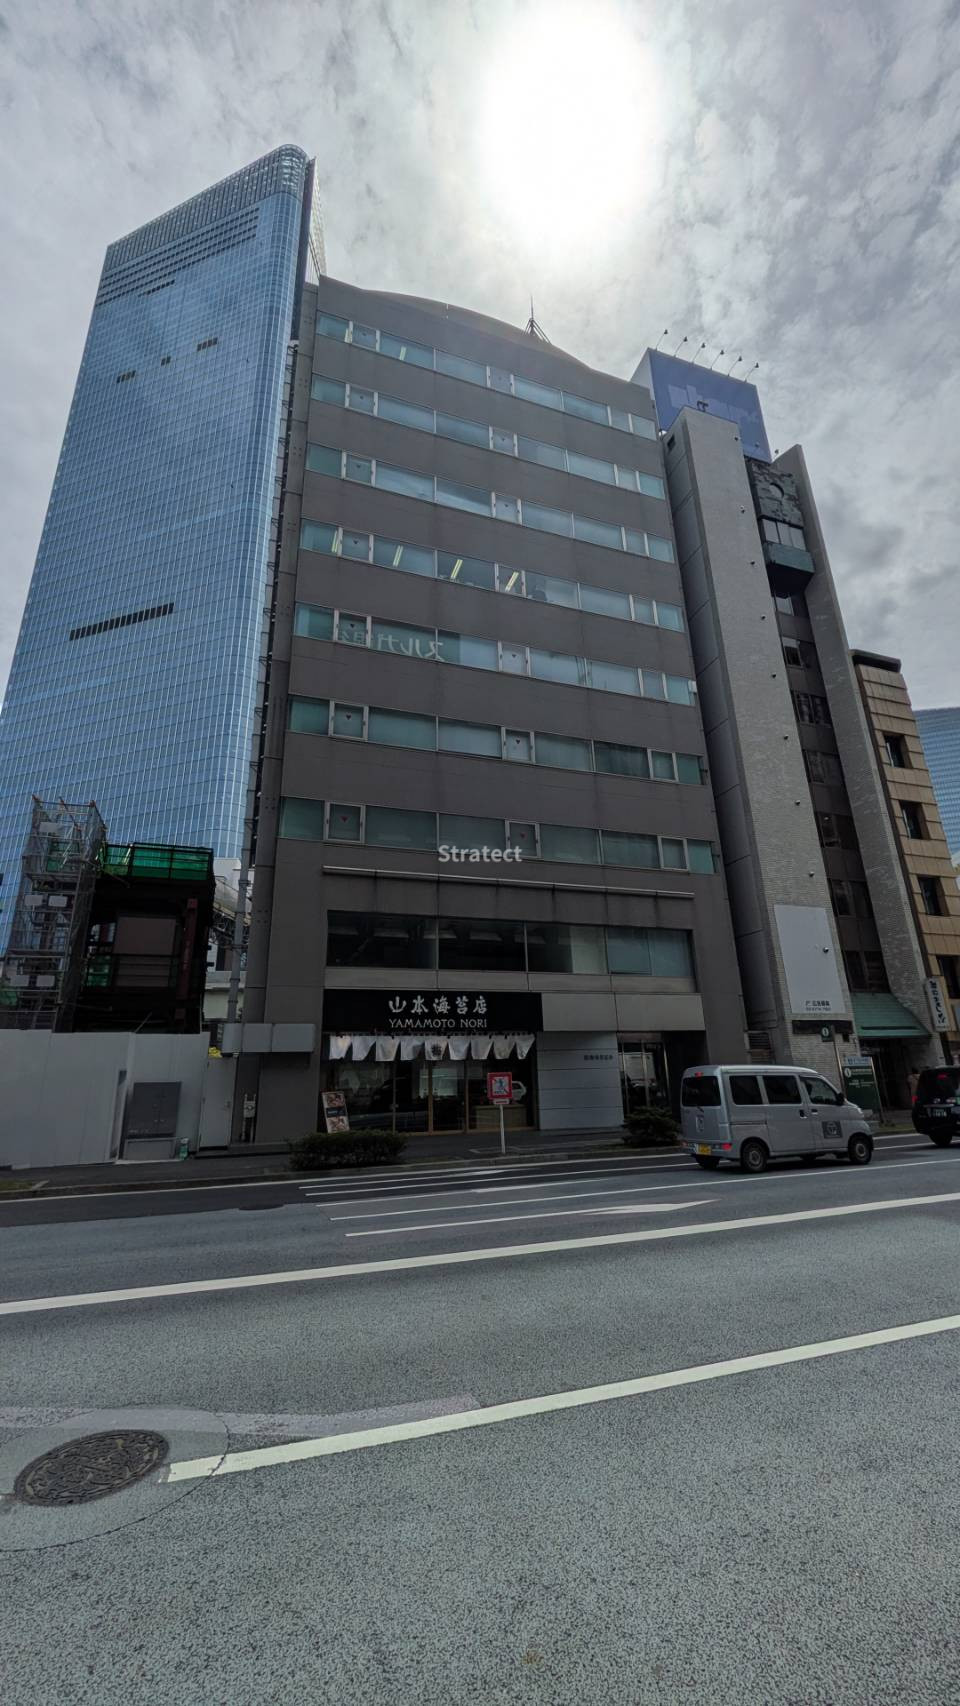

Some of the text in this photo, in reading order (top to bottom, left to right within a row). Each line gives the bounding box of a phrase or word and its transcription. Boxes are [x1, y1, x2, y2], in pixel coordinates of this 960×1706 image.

[388, 994, 488, 1015] 山本海苔店
[388, 1018, 488, 1029] YAMAMOTO NORI
